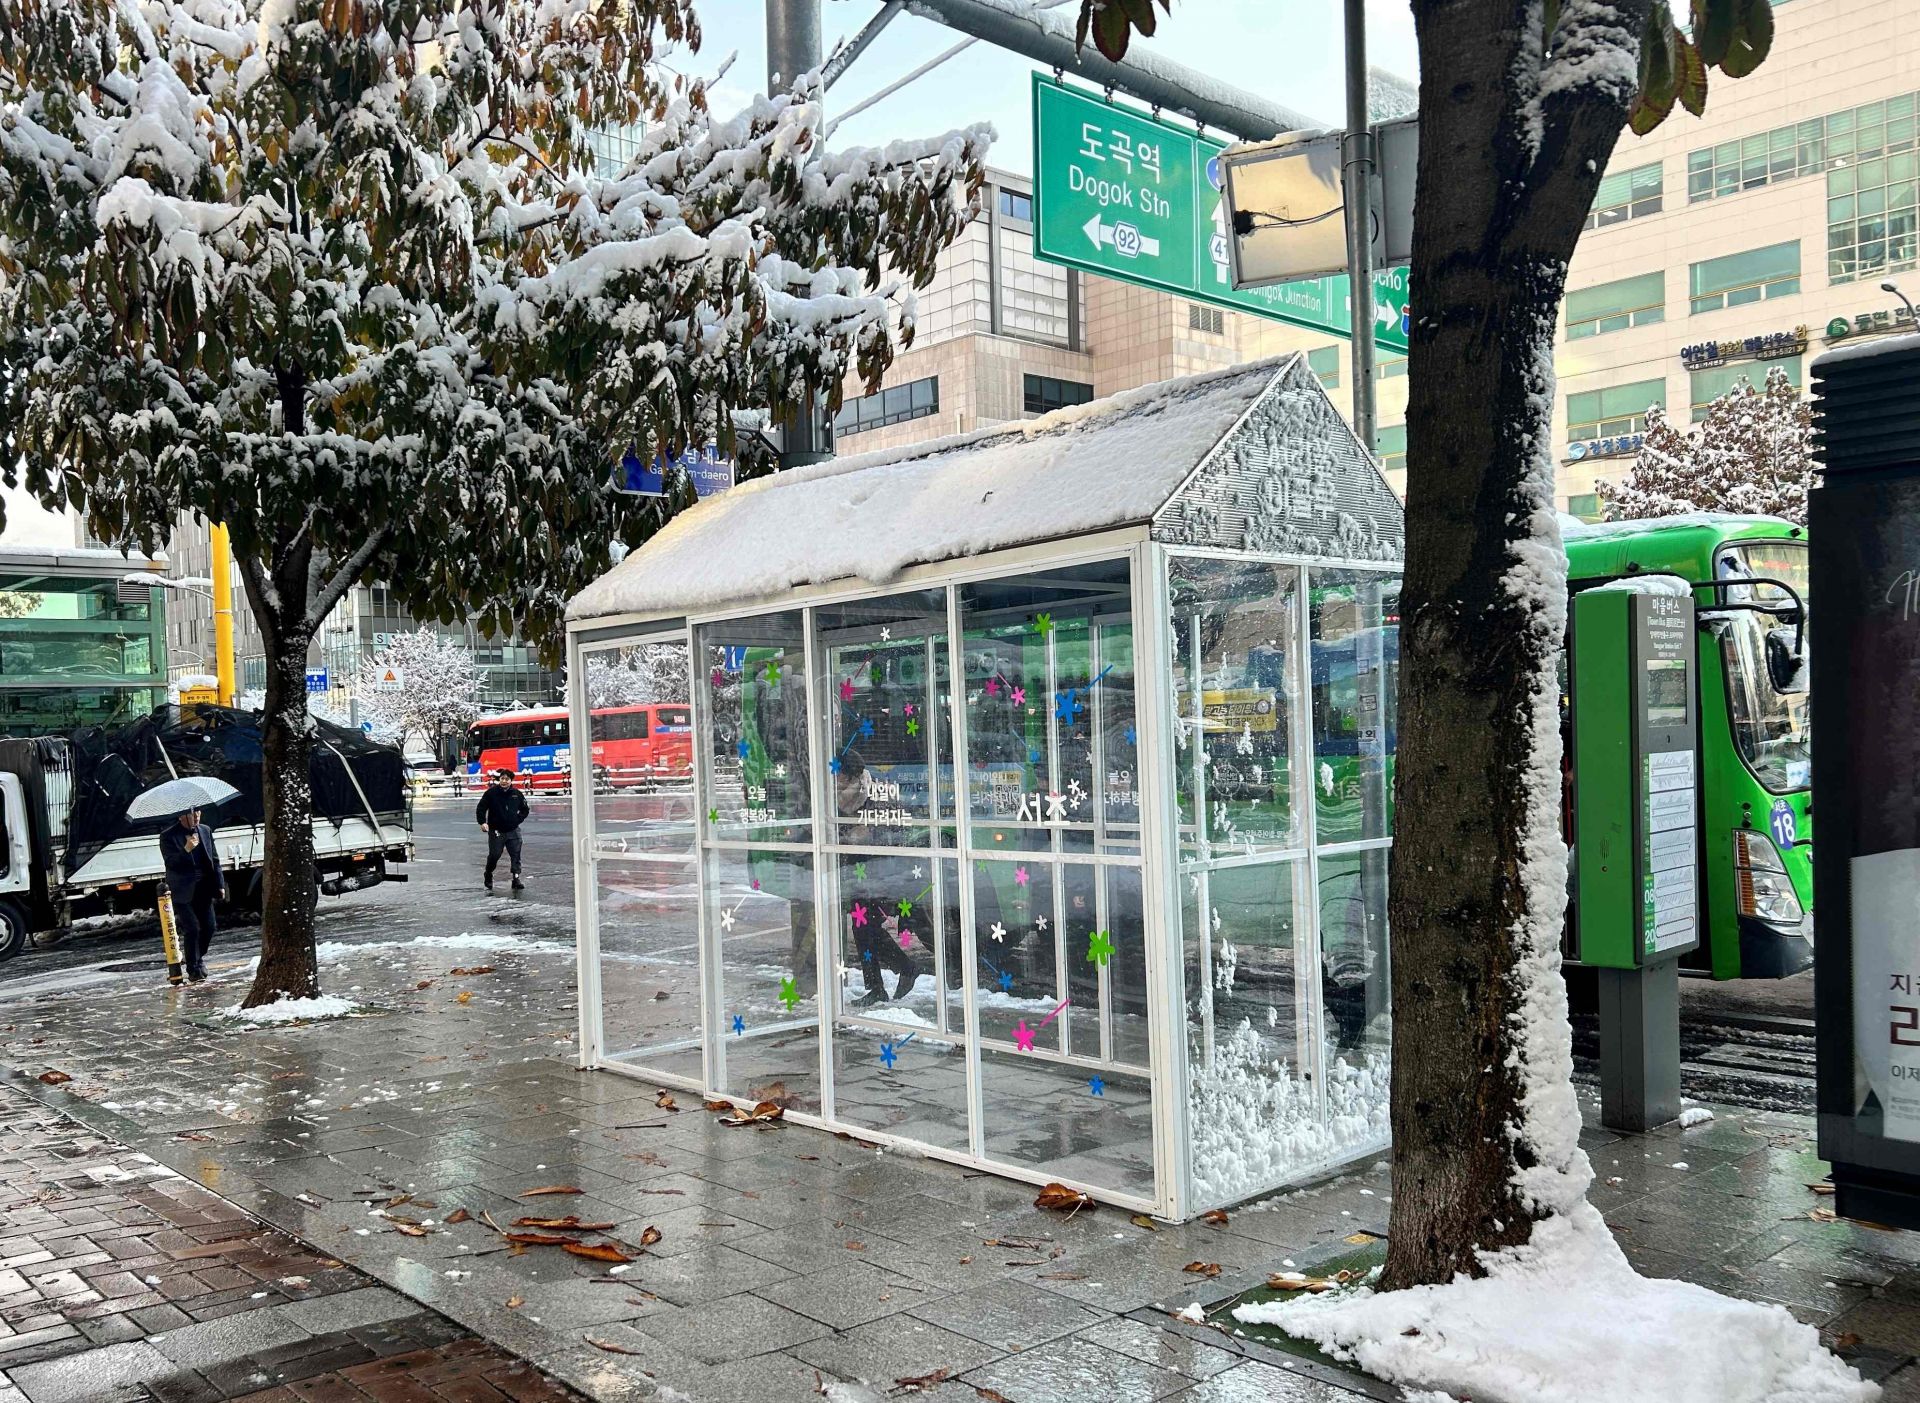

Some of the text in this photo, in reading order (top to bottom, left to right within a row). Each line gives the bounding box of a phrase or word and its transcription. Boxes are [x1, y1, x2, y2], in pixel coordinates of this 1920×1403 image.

[1080, 122, 1161, 184] 도곡역
[1069, 165, 1170, 219] Dogok Stn
[1118, 229, 1136, 251] 92
[1286, 288, 1322, 312] Junction
[1652, 597, 1680, 615] 마을버스
[748, 785, 767, 801] 오늘
[867, 783, 899, 801] 내일이
[739, 808, 777, 825] 행복하고
[857, 808, 913, 827] 기다려지는
[1016, 792, 1071, 827] 서초
[1773, 813, 1795, 845] 18
[1644, 928, 1655, 945] 20
